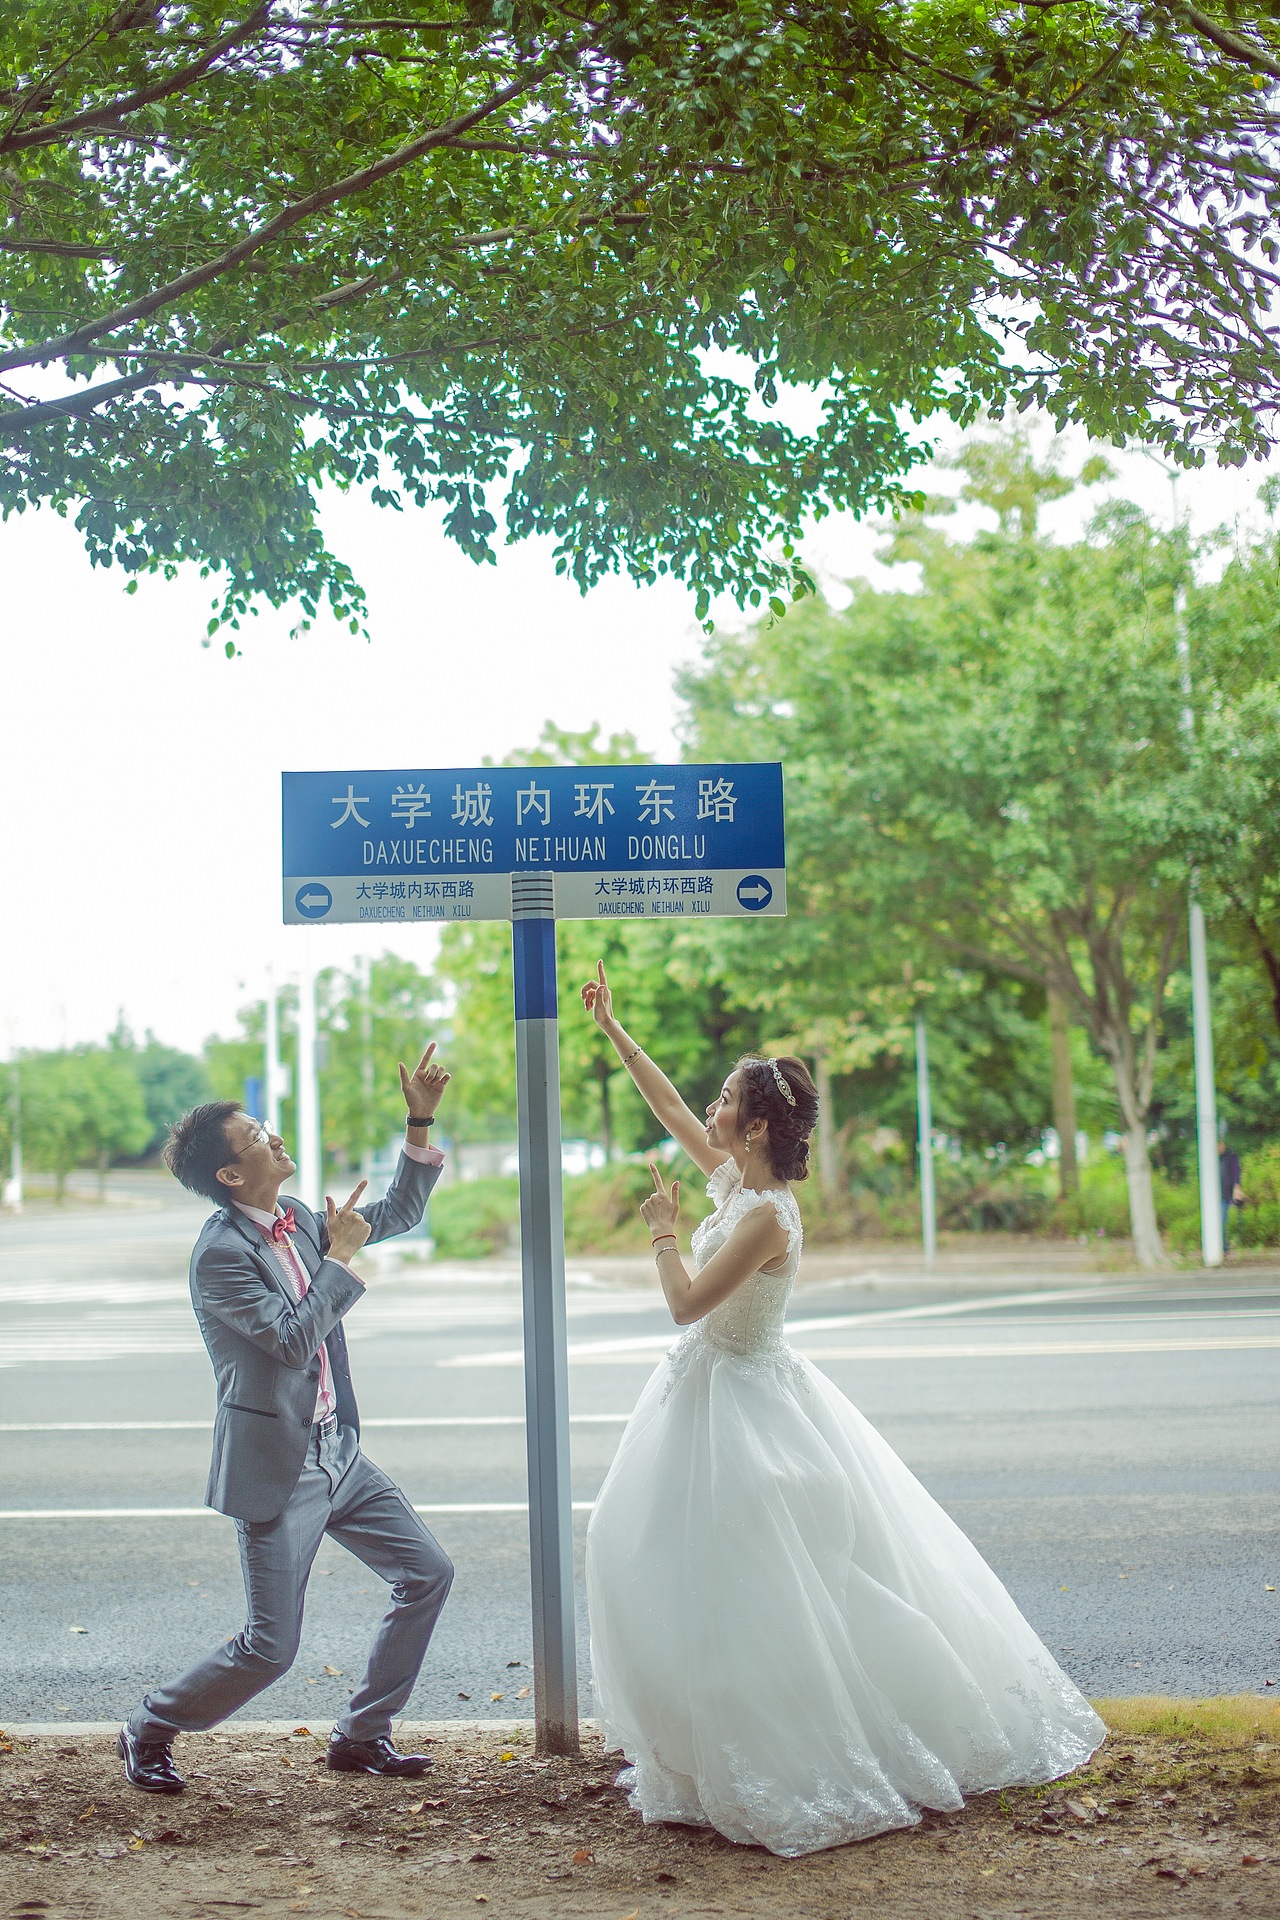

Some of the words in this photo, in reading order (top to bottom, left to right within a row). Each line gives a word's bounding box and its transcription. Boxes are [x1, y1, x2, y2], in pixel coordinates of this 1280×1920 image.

[330, 777, 738, 829] 大学城内环东路
[363, 838, 493, 865] DAXUECHENG
[516, 836, 606, 862] NEIHUAN
[628, 834, 706, 860] DONGLU
[356, 880, 475, 900] 大学城内环西路
[594, 876, 714, 896] 大学城内环西路
[359, 905, 405, 919] DAXUECHENG
[412, 905, 445, 917] NEIHUAN
[452, 904, 471, 917] XILU
[598, 901, 645, 914] DAXUECHENG
[652, 901, 684, 913] NEIHUAN
[691, 900, 711, 913] XILU
